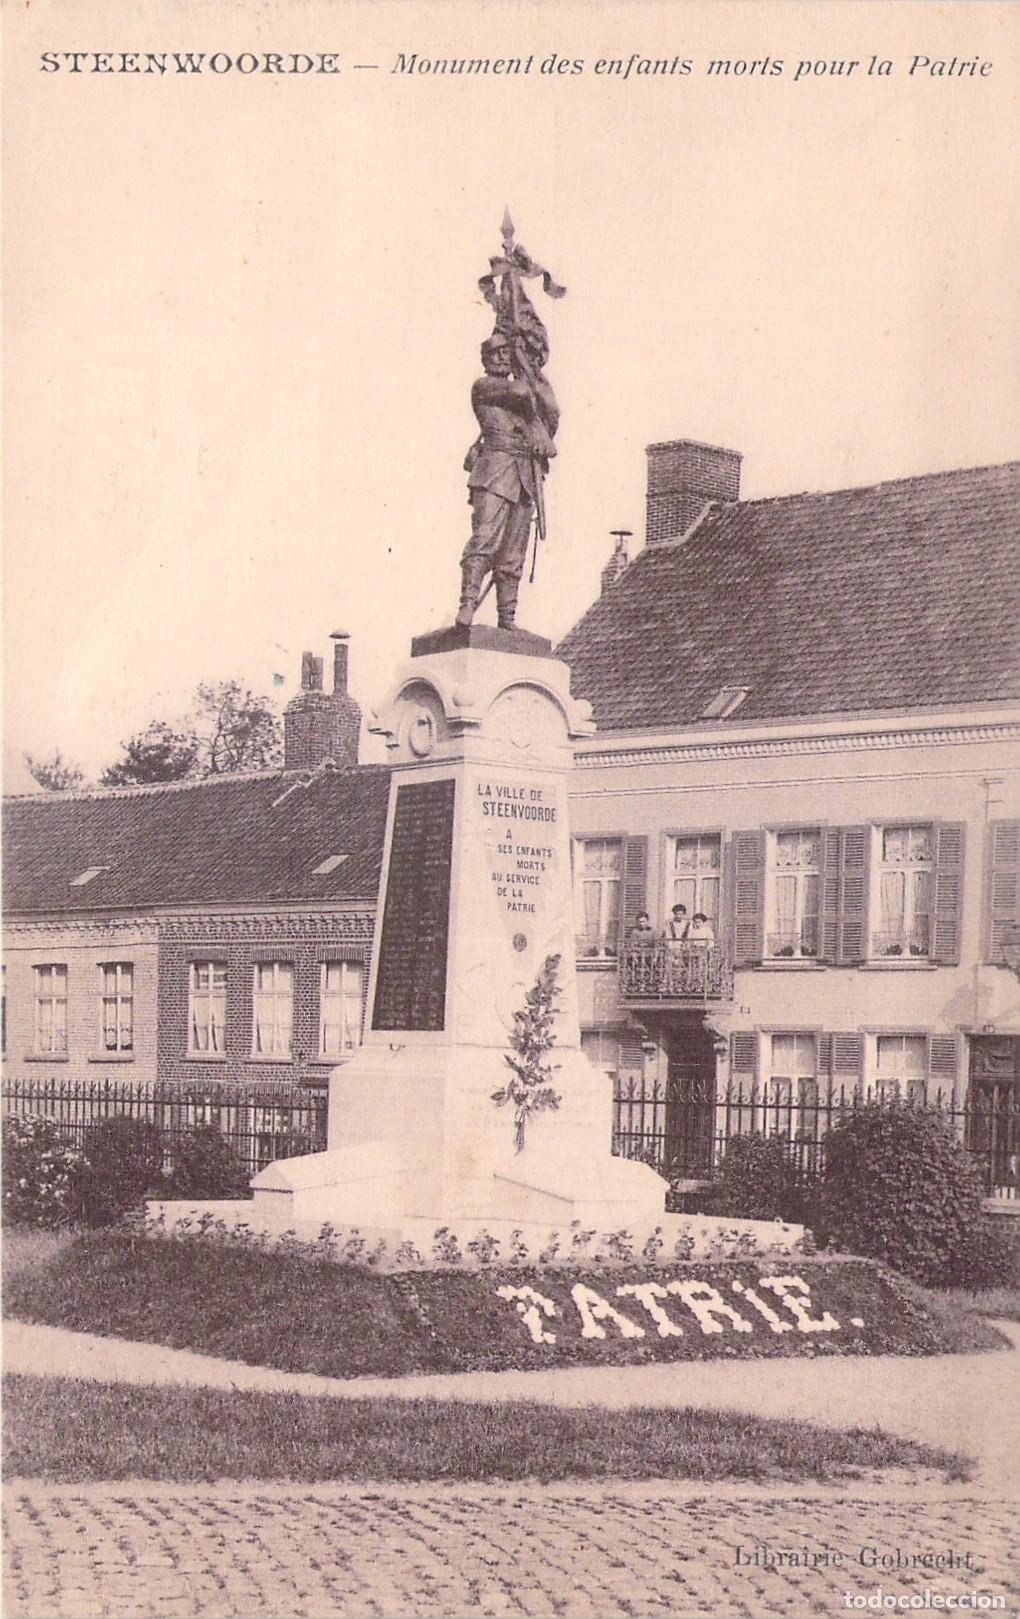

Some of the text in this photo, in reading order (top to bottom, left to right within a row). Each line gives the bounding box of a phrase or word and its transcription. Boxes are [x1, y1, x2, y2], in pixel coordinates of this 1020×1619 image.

[478, 784, 543, 802] LA VILLE DE
[482, 801, 557, 822] STEENVOORDE
[506, 829, 512, 839] A
[497, 844, 552, 858] SES ENFANTS
[517, 861, 546, 871] MORTS
[491, 872, 540, 885] AU SERVICE
[496, 887, 523, 898] DE LA
[507, 902, 536, 913] PATRIE
